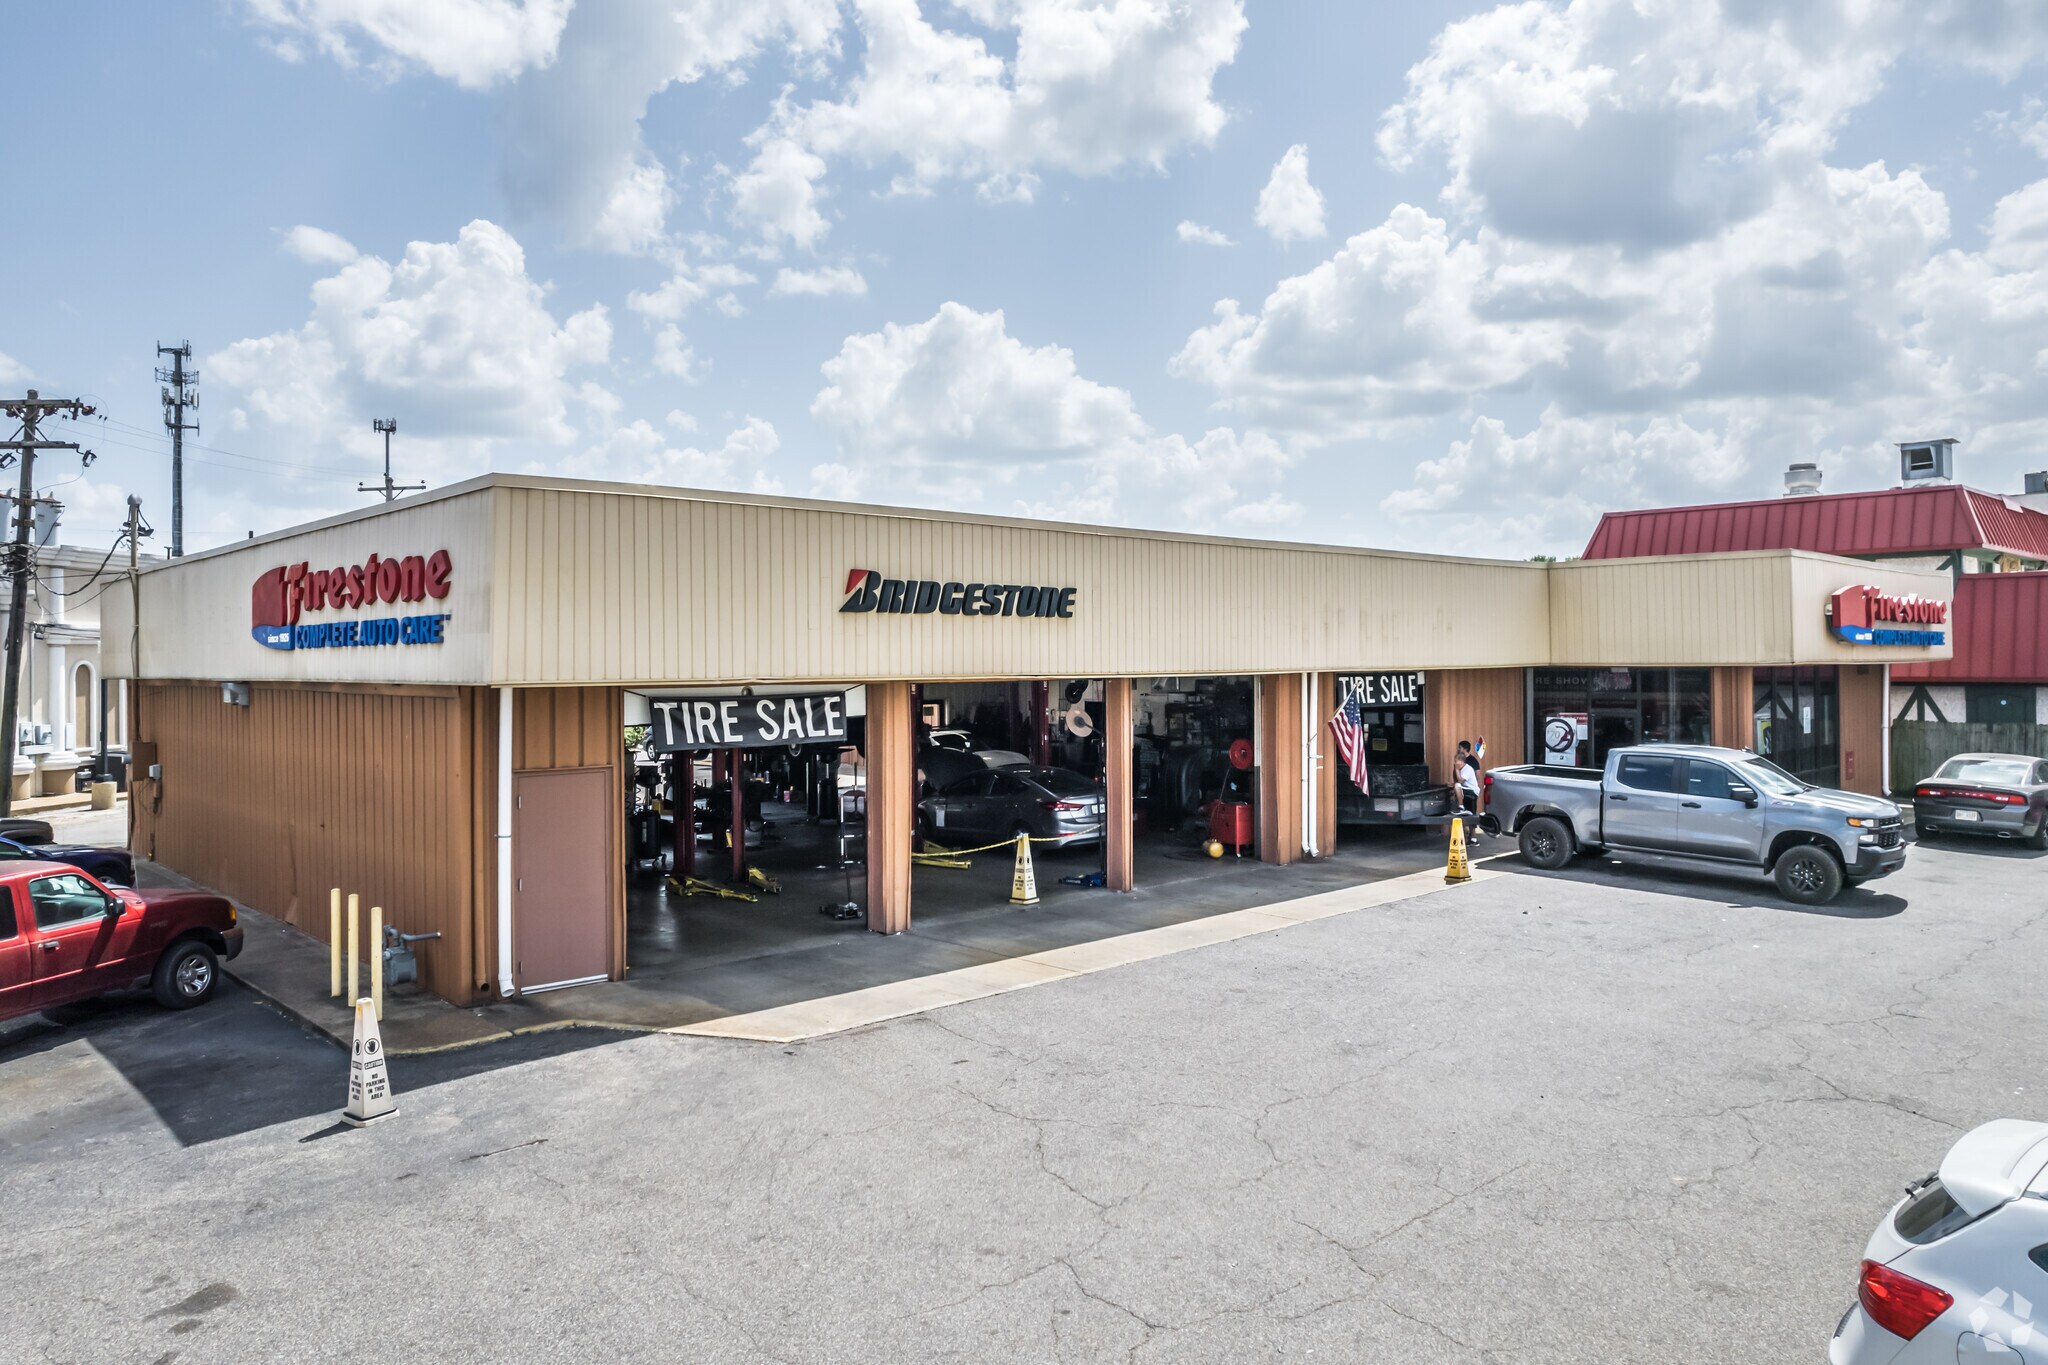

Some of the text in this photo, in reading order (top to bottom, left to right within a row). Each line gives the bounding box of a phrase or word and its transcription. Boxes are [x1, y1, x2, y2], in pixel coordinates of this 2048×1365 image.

[287, 549, 452, 624] Firestone
[839, 568, 1077, 618] BRIDGESTONE
[1868, 586, 1947, 627] Firestone
[296, 614, 445, 649] COMPLETE AUTO CARE
[1380, 675, 1418, 703] SALE
[653, 696, 844, 745] TIRE SALE
[366, 1078, 385, 1088] PARKING
[371, 1092, 383, 1100] AREA
